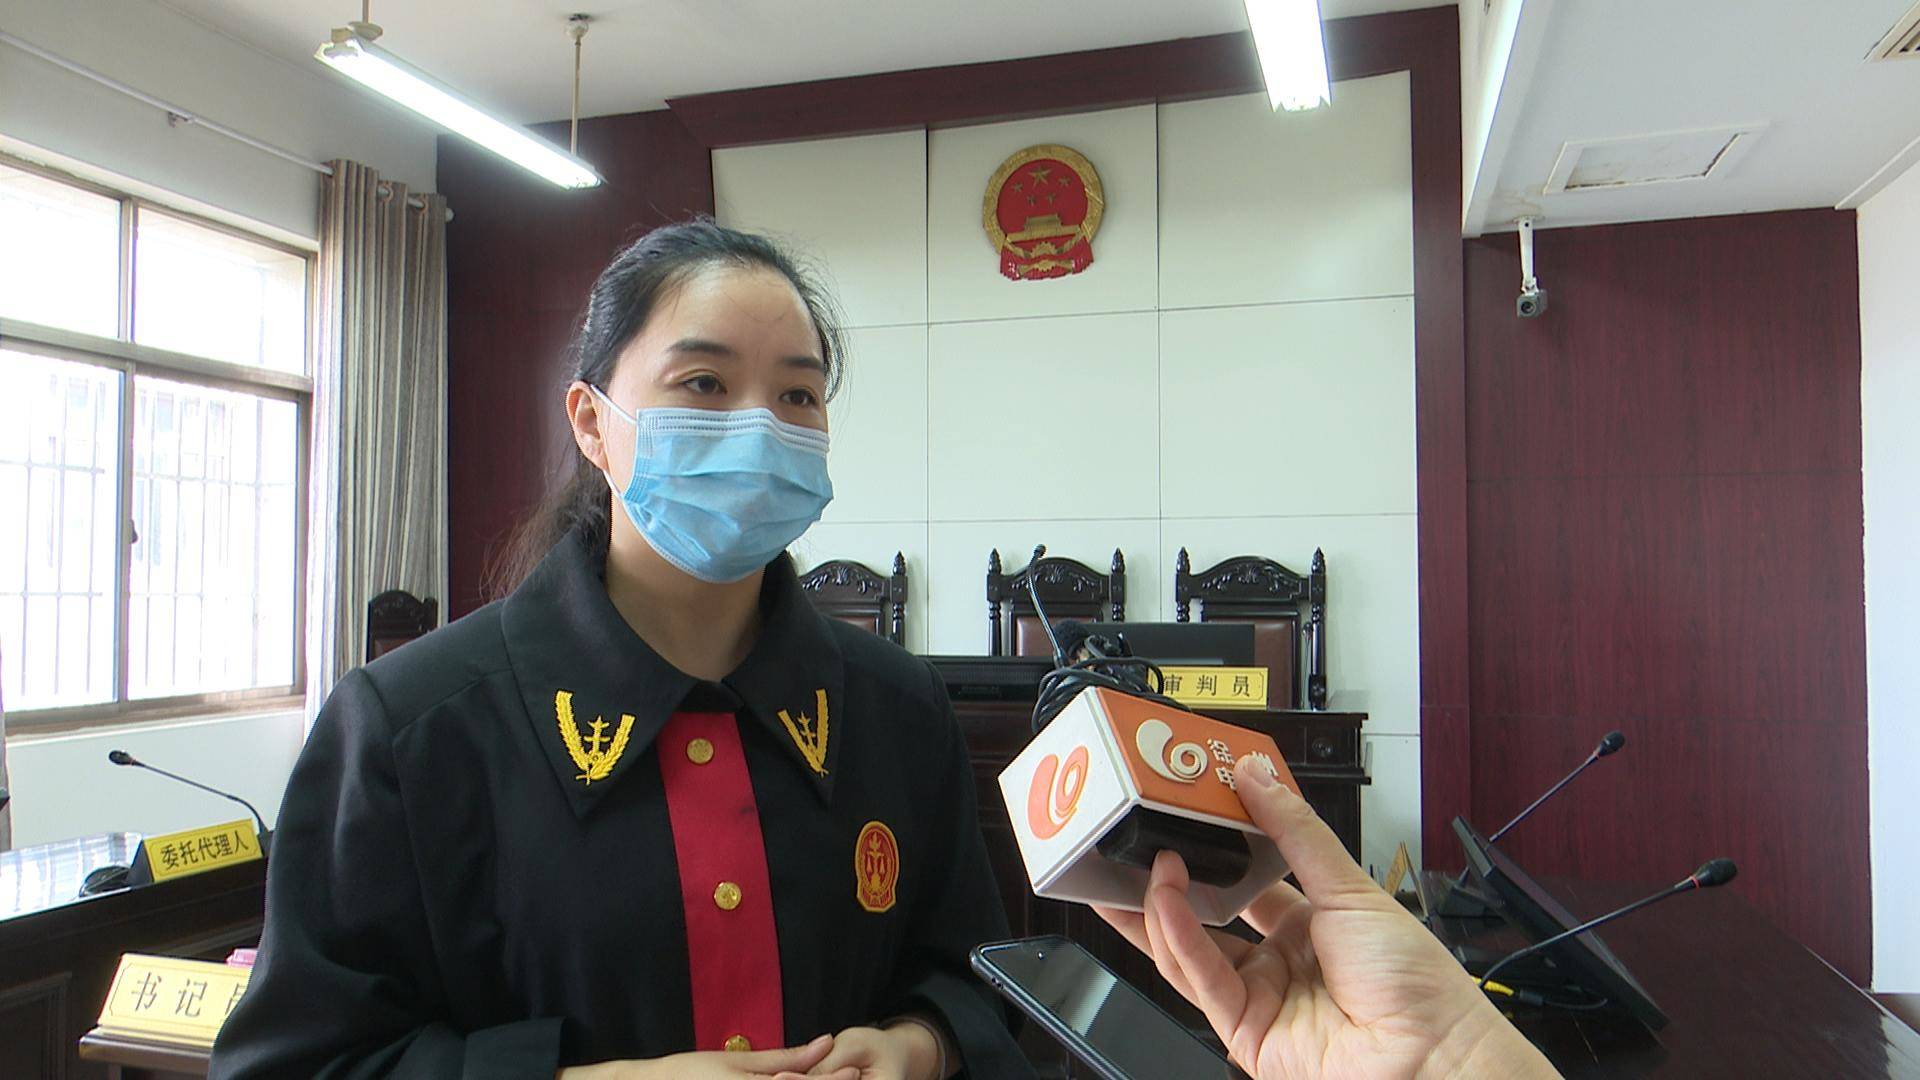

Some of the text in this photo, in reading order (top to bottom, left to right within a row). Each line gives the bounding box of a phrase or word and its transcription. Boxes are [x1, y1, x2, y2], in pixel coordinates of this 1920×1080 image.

[1163, 673, 1250, 697] 审判员
[160, 829, 249, 870] 委托代理人
